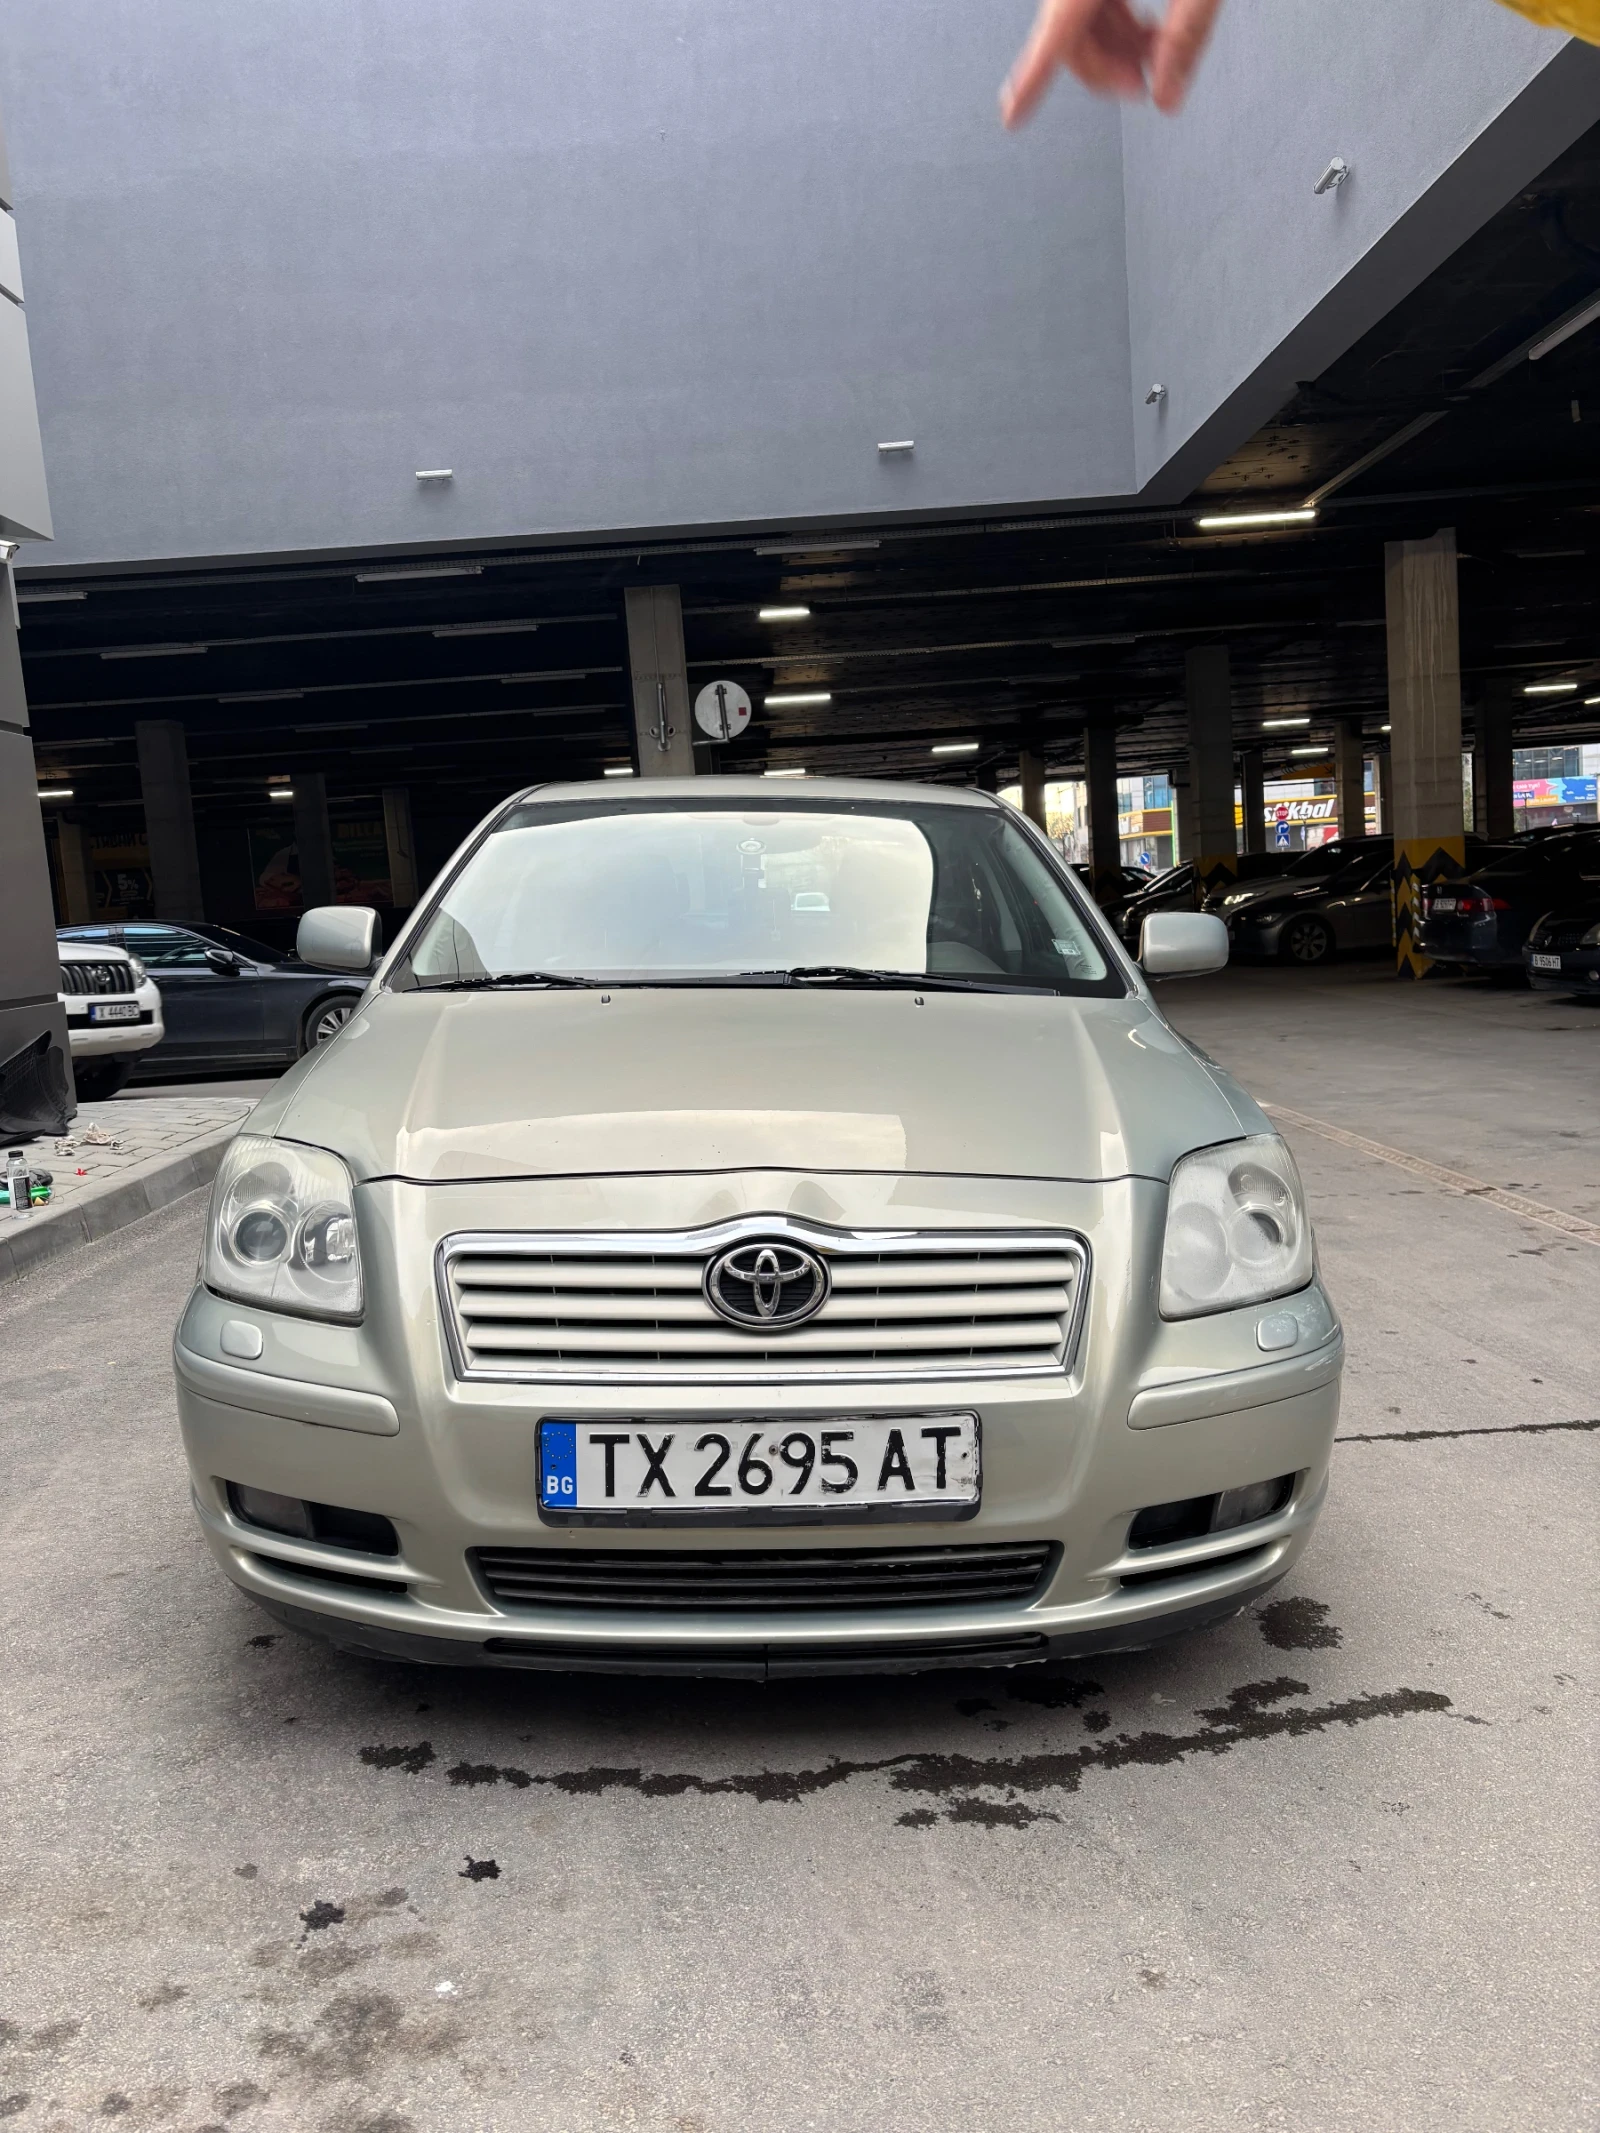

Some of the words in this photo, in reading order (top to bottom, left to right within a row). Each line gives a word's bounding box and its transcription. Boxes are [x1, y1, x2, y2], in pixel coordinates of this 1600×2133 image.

[117, 873, 139, 890] 5%
[589, 1433, 677, 1498] TX
[693, 1430, 859, 1496] 2695
[877, 1426, 962, 1491] AT
[546, 1475, 574, 1495] BG
